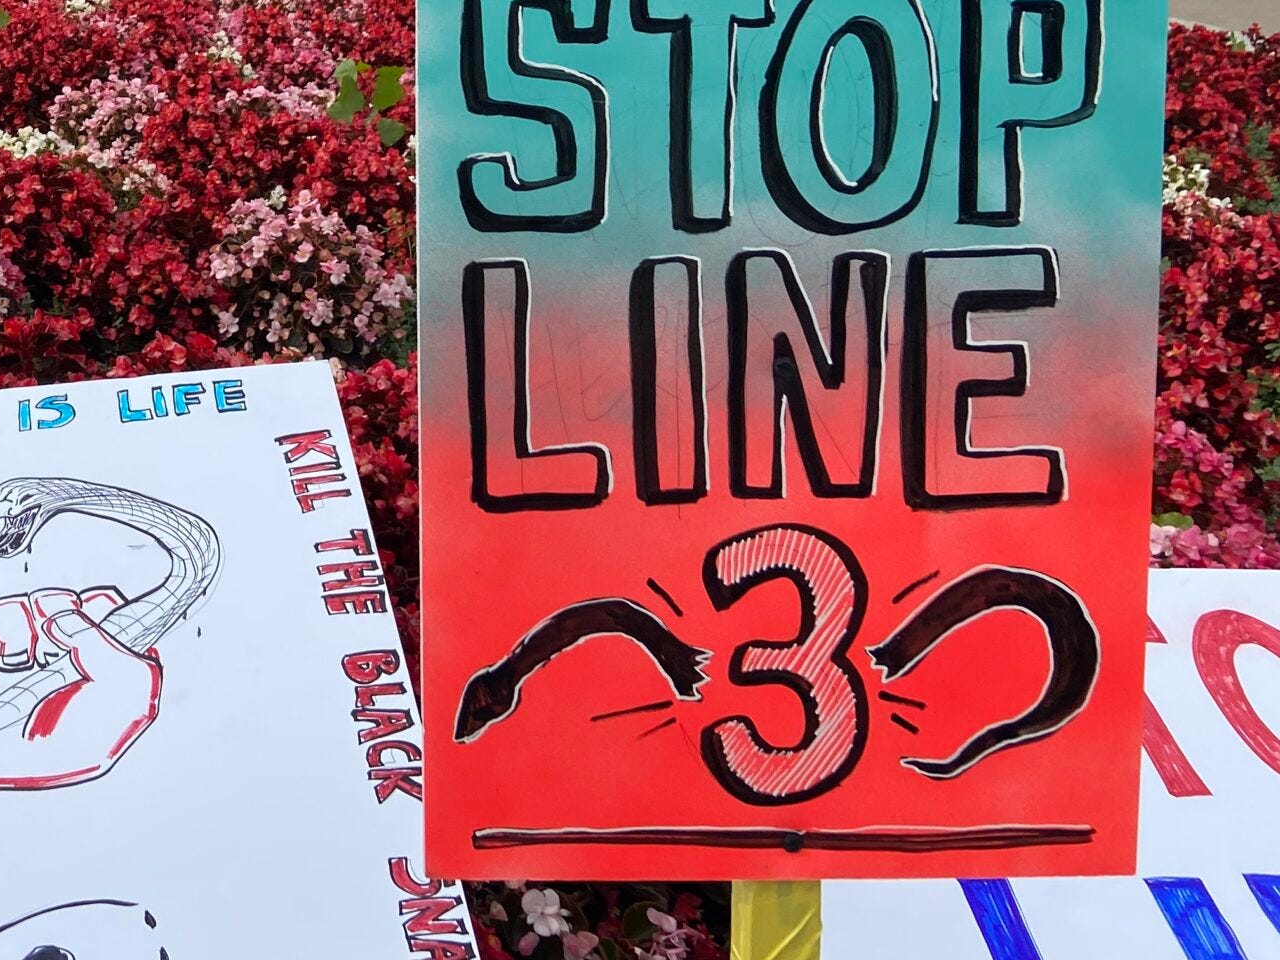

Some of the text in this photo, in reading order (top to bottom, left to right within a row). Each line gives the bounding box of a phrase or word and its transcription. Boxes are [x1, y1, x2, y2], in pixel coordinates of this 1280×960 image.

[19, 393, 77, 432] IS
[118, 379, 248, 424] LIFE
[463, 245, 1070, 512] LINE
[274, 428, 353, 515] KILL
[313, 527, 388, 617] THE
[699, 521, 872, 808] 3
[340, 648, 423, 805] BLACK
